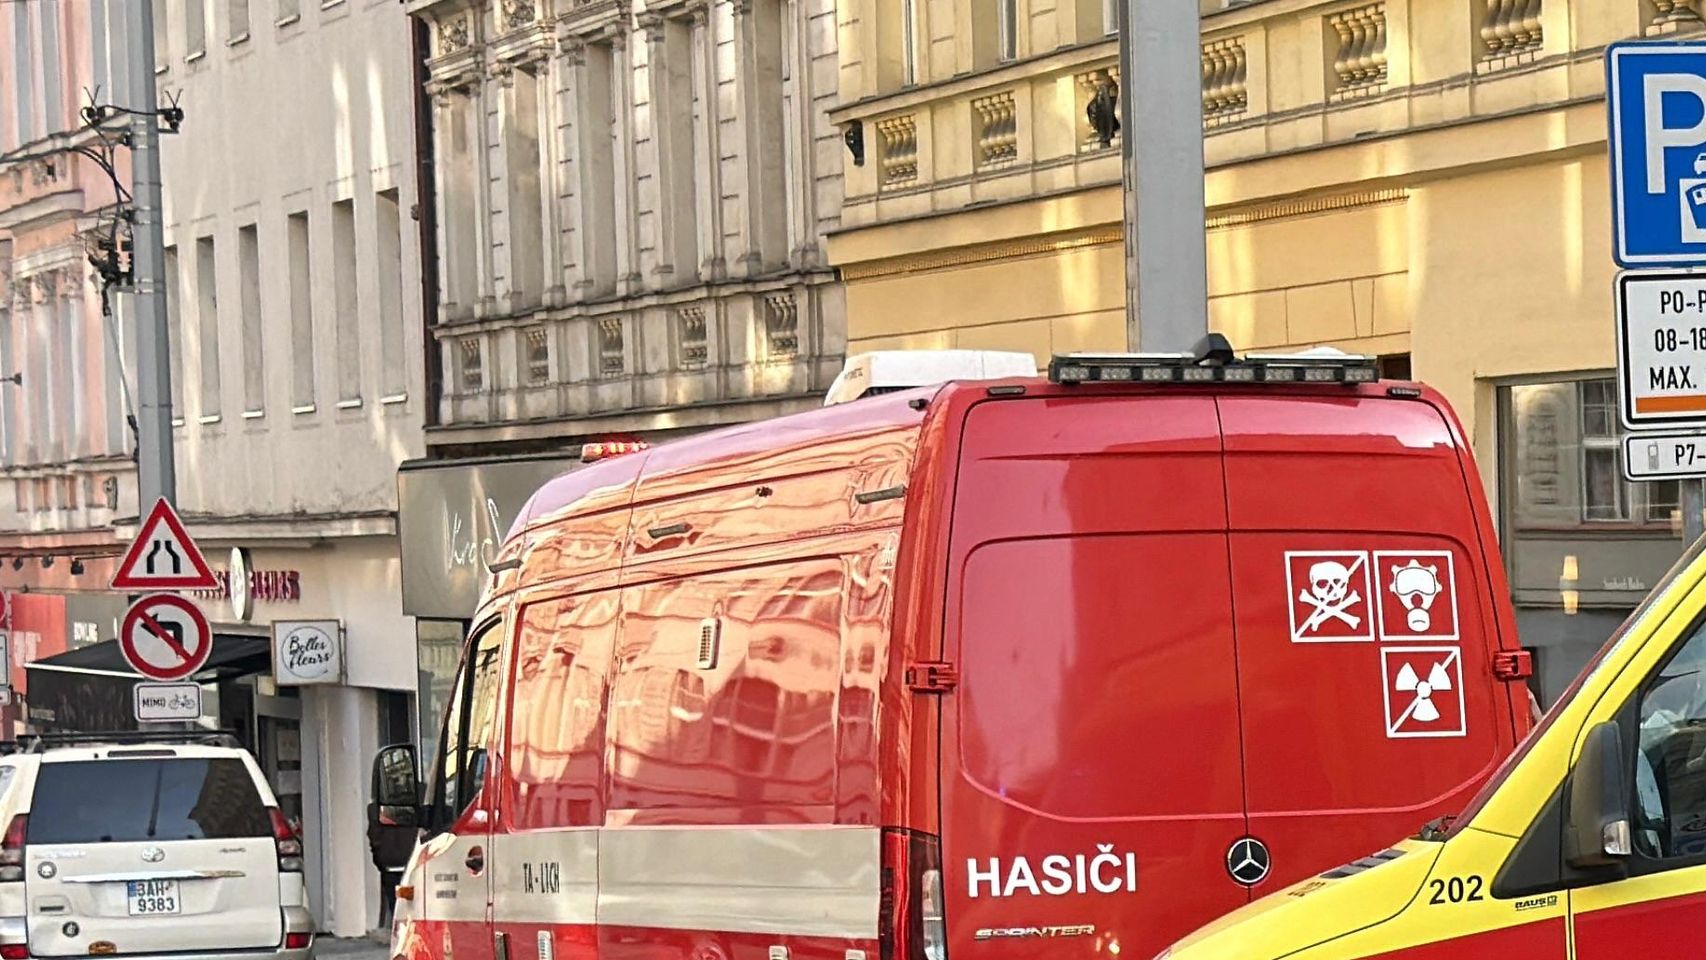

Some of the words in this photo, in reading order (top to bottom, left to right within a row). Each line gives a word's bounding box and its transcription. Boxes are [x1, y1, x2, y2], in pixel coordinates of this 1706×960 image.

[1650, 365, 1697, 390] MAX.
[143, 697, 166, 708] MIMO
[967, 843, 1136, 897] HASIČI
[1429, 874, 1484, 905] 202
[138, 897, 175, 912] 9383
